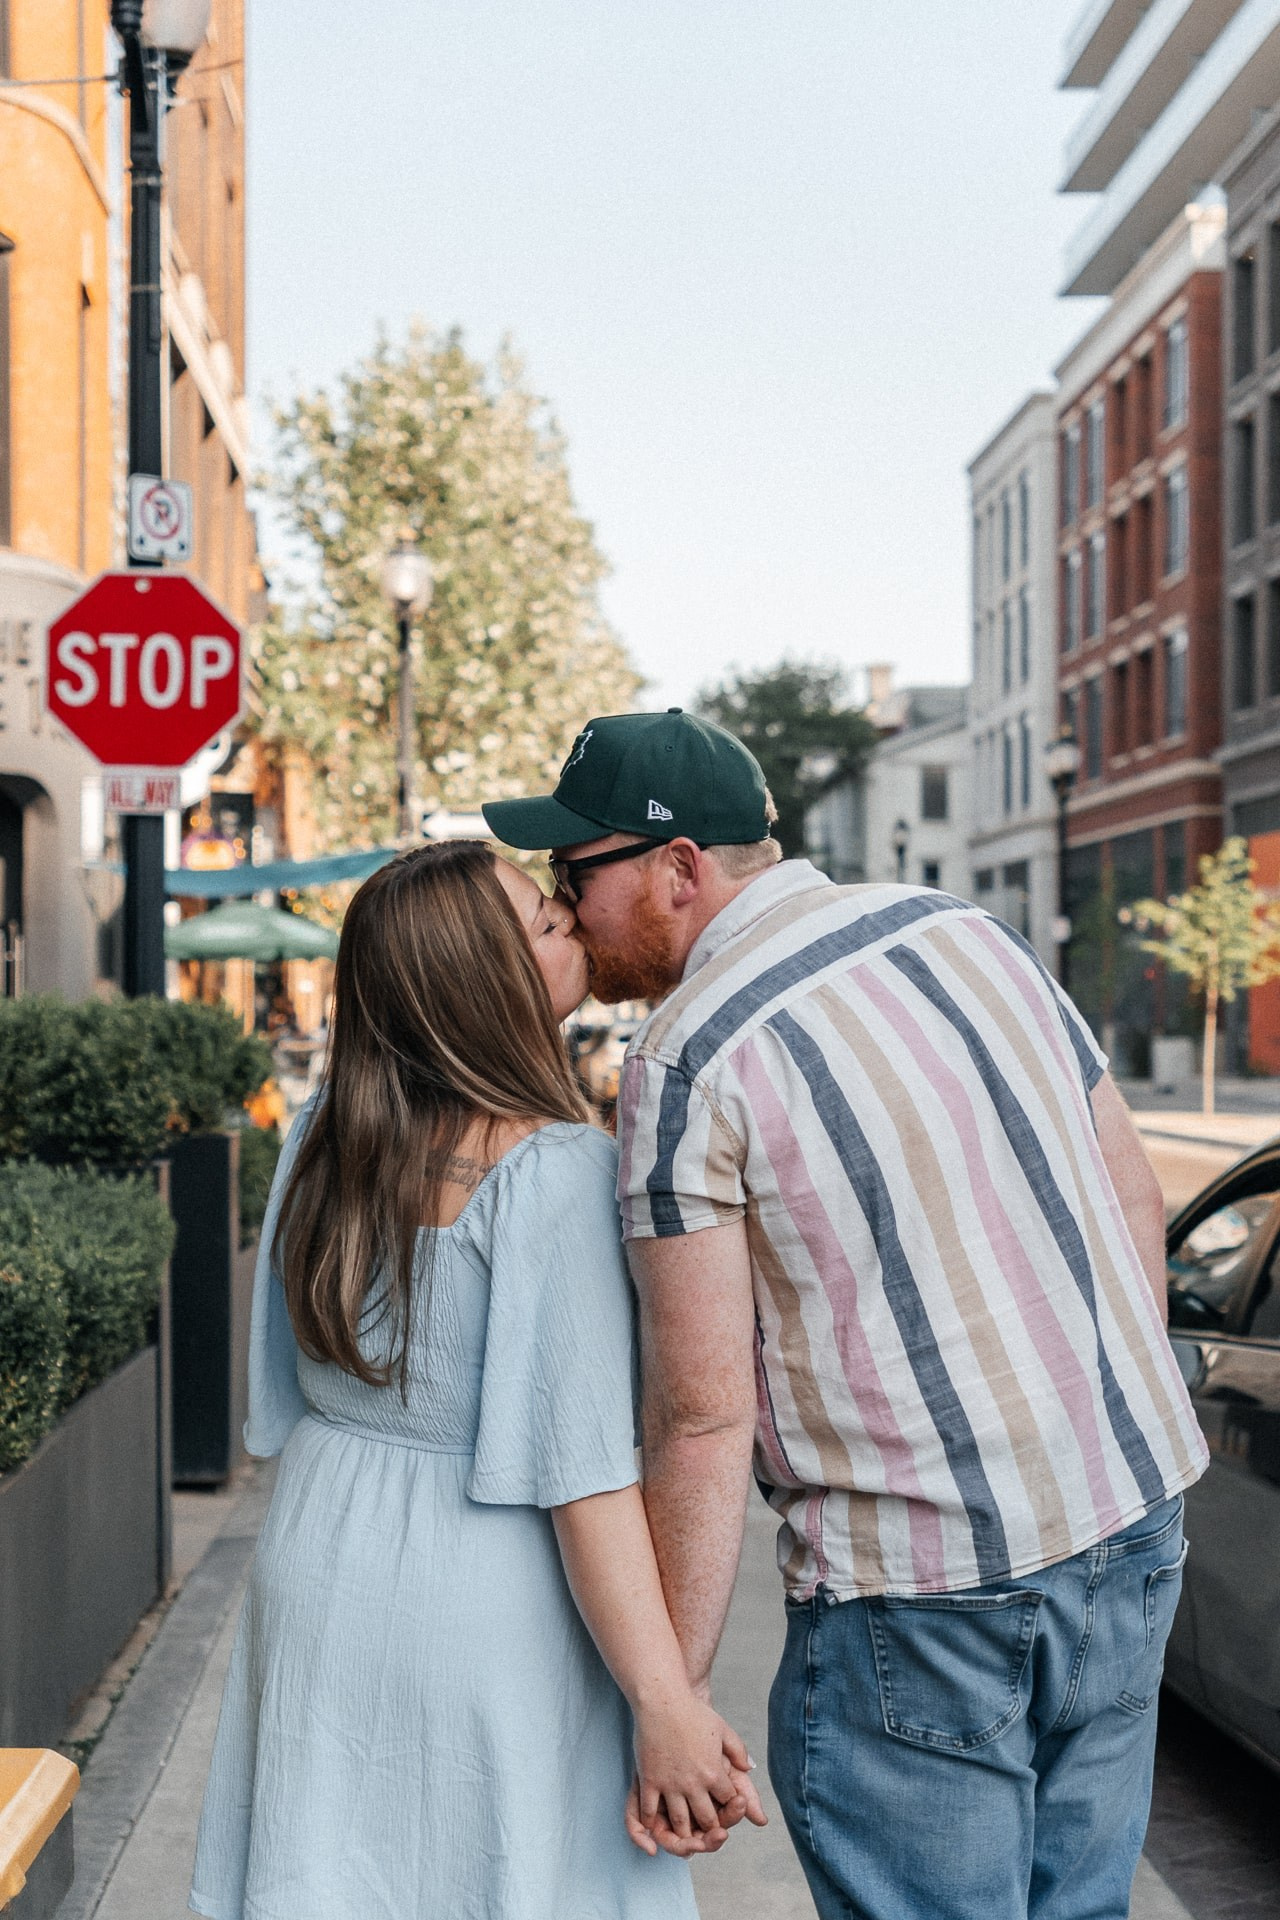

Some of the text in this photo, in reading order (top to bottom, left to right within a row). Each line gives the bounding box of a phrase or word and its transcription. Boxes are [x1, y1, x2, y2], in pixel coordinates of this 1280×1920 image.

[54, 630, 235, 710] STOP
[108, 779, 174, 807] ALL WAY
